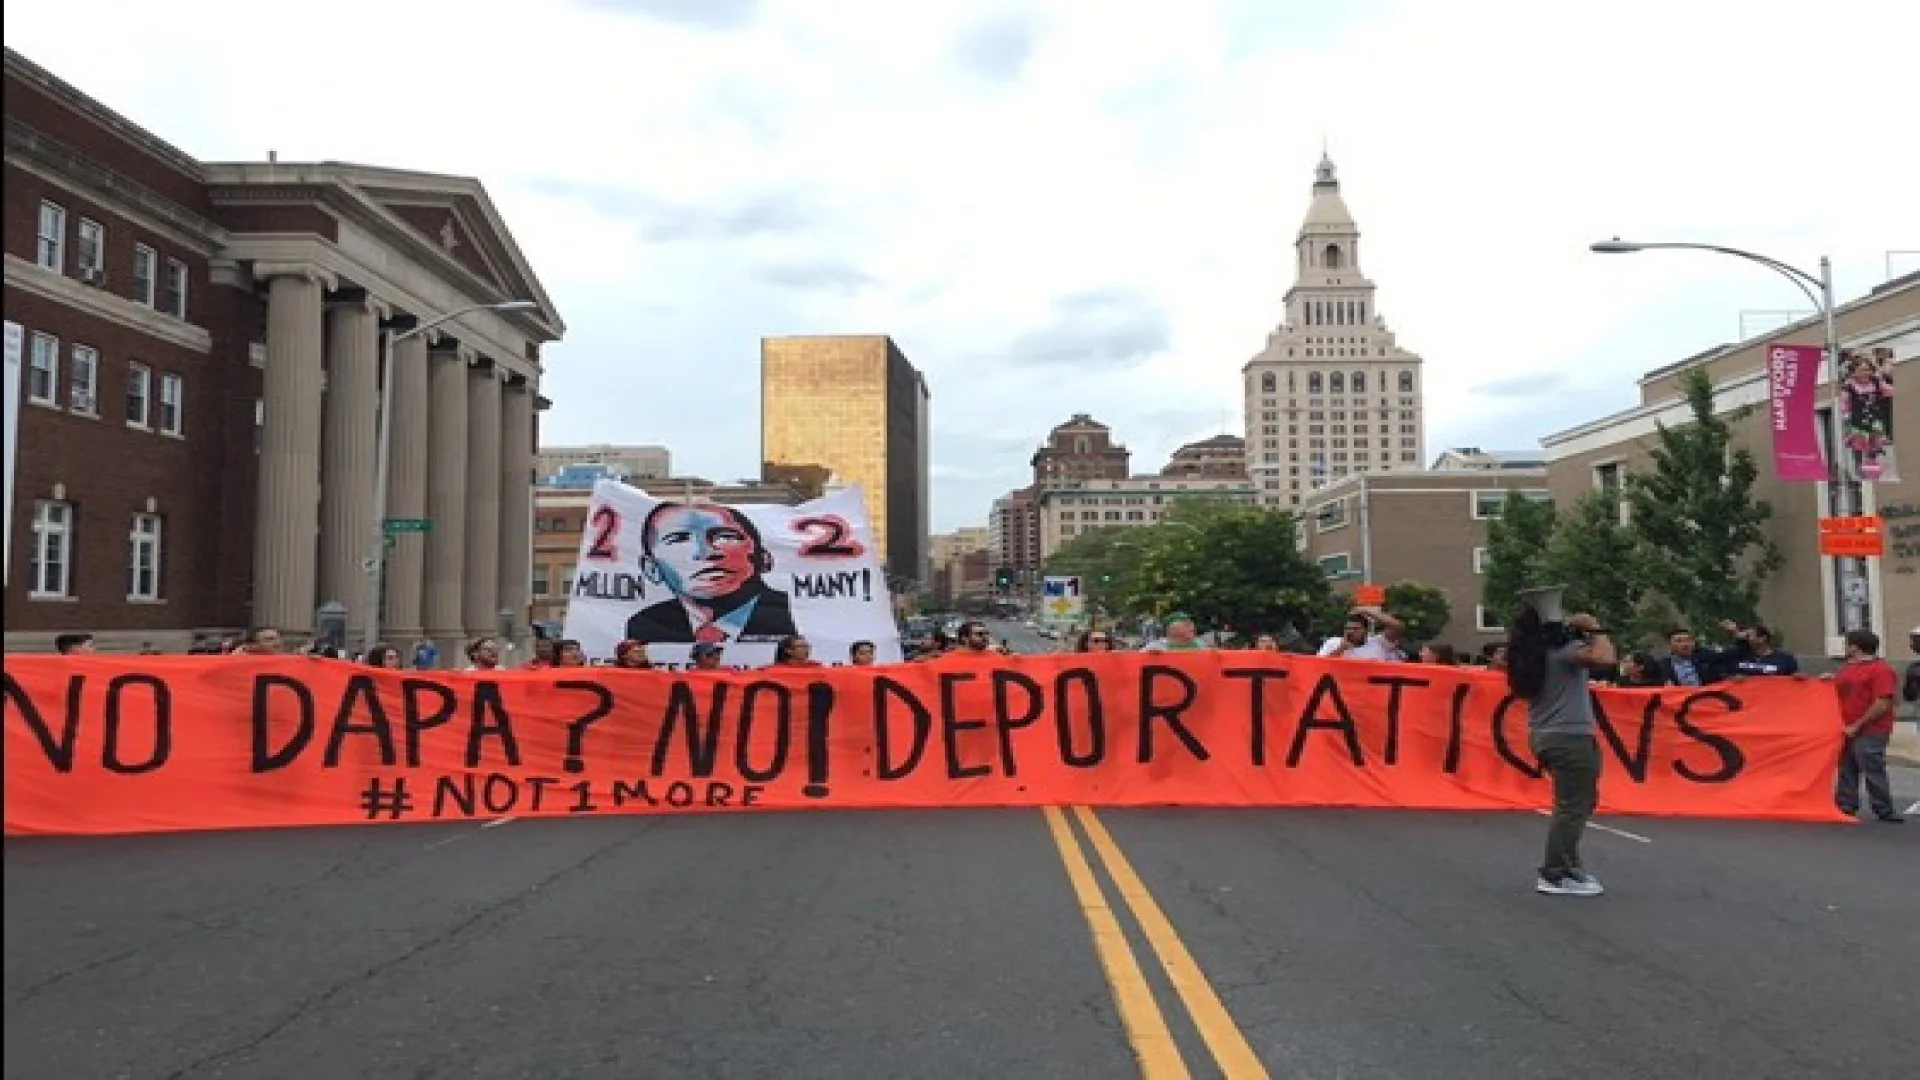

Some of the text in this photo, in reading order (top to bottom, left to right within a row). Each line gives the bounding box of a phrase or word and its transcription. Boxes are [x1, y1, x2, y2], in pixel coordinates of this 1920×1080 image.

[587, 503, 620, 562] 2
[791, 514, 864, 560] 2
[576, 571, 645, 600] MILLION
[791, 568, 871, 602] MANY!
[4, 674, 171, 774] NO
